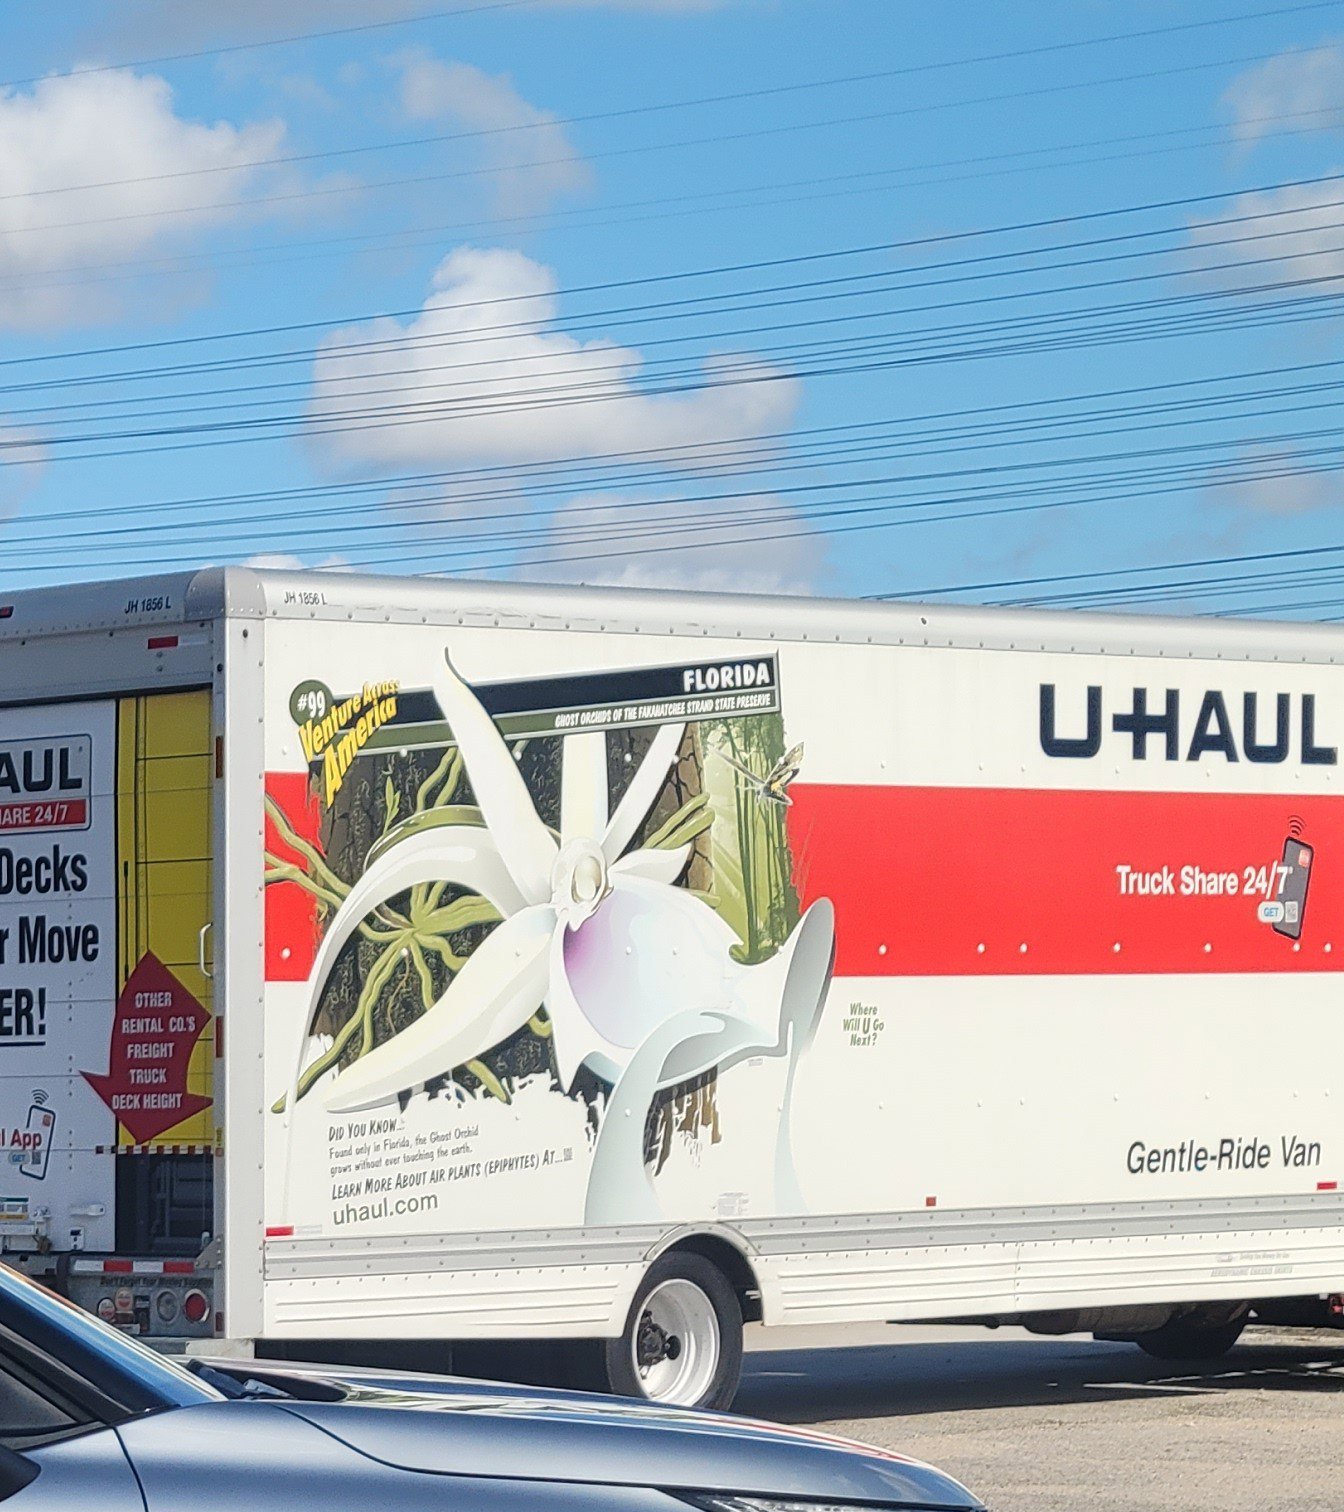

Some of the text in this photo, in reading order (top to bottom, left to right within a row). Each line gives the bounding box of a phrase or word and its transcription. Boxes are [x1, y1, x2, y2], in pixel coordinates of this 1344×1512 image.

[124, 596, 172, 614] JH 1856 L
[284, 591, 328, 606] JH 1856 L
[683, 662, 770, 693] FLORIDA
[297, 690, 326, 718] #99
[555, 712, 580, 728] GHOST
[580, 710, 611, 725] ORCHIDS
[612, 708, 623, 721] OF
[624, 707, 637, 720] THE
[687, 699, 714, 714] STRAND
[714, 697, 735, 711] STATE
[736, 694, 771, 709] PRESERVE
[299, 680, 400, 764] Venture Across
[1039, 683, 1338, 766] U-HAUL
[324, 697, 397, 809] America
[34, 802, 69, 825] 24/7
[1116, 864, 1175, 895] Truck
[1179, 864, 1239, 896] Share
[1263, 907, 1279, 917] GET
[18, 915, 99, 964] Move
[135, 991, 172, 1008] OTHER
[850, 1002, 878, 1016] Where
[122, 1016, 196, 1034] RENTAL CO.'S
[843, 1018, 885, 1034] Will U Go
[127, 1042, 174, 1059] FREIGHT
[850, 1033, 877, 1046] Next?
[129, 1068, 167, 1084] TRUCK
[112, 1093, 183, 1110] DECK HEIGHT
[10, 1128, 43, 1150] App
[329, 1125, 479, 1159] Found only in Florida, the Ghost Orchid
[12, 1154, 27, 1163] GET
[330, 1142, 473, 1177] grows without ever touching the earth.
[1127, 1135, 1322, 1174] Gentle-Ride Van
[332, 1182, 362, 1200] LEARN
[364, 1177, 392, 1194] MORE
[394, 1170, 427, 1189] ABOUT
[430, 1168, 445, 1184] AIR
[448, 1162, 481, 1181] PLANTS
[484, 1153, 540, 1178] (EPIPHYTES)
[333, 1194, 438, 1225] uhaul.com
